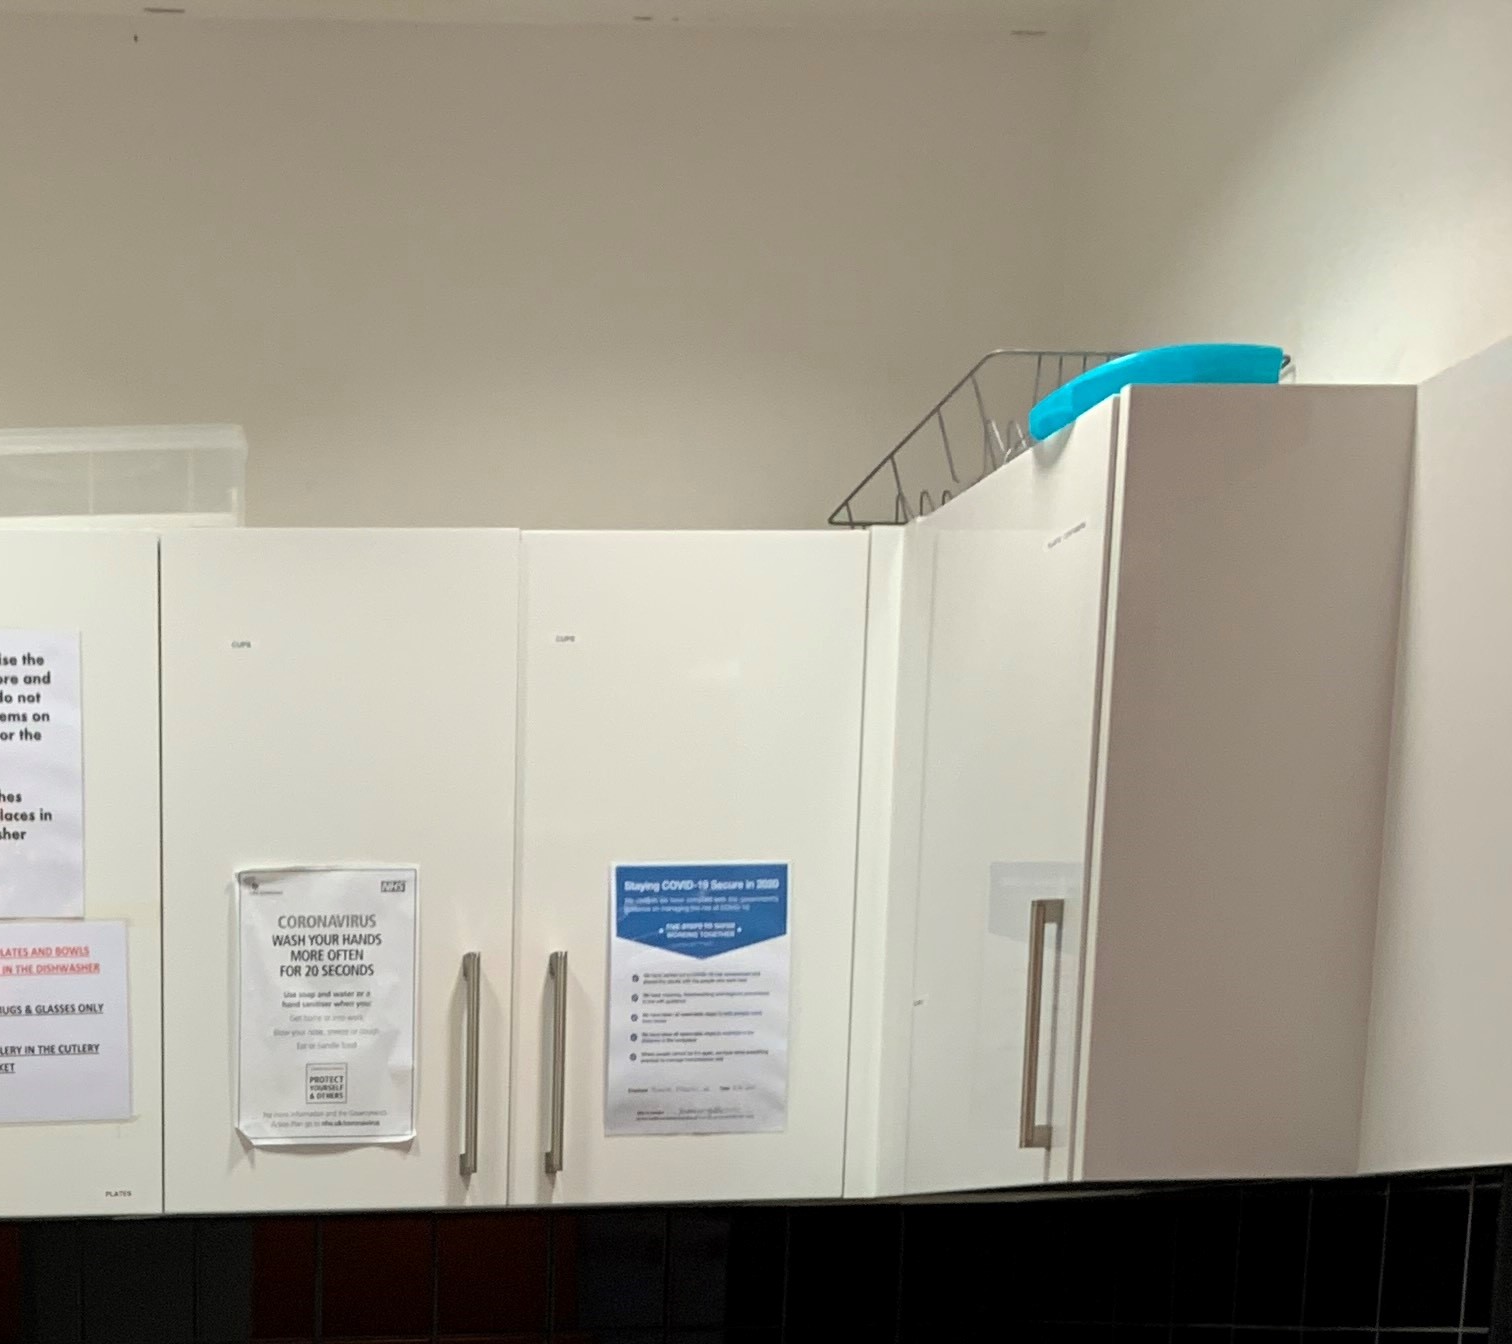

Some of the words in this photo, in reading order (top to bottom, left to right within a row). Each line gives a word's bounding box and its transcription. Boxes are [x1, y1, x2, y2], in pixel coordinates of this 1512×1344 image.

[22, 652, 44, 666] the
[24, 671, 51, 685] and
[18, 691, 41, 703] not
[32, 712, 50, 722] on
[0, 731, 15, 741] or
[20, 728, 42, 741] the
[40, 809, 52, 821] in
[381, 881, 405, 892] NHS
[624, 881, 660, 892] Staying
[662, 879, 709, 890] COVID-19
[711, 879, 744, 890] Secure
[745, 880, 754, 889] in
[278, 914, 376, 929] CORONAVIRUS
[272, 935, 306, 946] WASH
[309, 934, 339, 945] YOUR
[343, 934, 382, 945] HANDS
[31, 947, 52, 957] AND
[55, 946, 89, 956] BOWLS
[290, 950, 324, 961] MORE
[328, 949, 364, 960] OFTEN
[3, 965, 12, 974] IN
[16, 965, 33, 974] THE
[36, 963, 100, 973] DISHWASHER
[280, 965, 302, 977] FOR
[305, 965, 319, 977] 20
[322, 964, 374, 976] SECONDS
[25, 1005, 32, 1014] &
[35, 1004, 75, 1014] GLASSES
[78, 1003, 104, 1013] ONLY
[25, 1046, 35, 1055] IN
[38, 1045, 55, 1054] THE
[58, 1044, 99, 1053] CUTLERY
